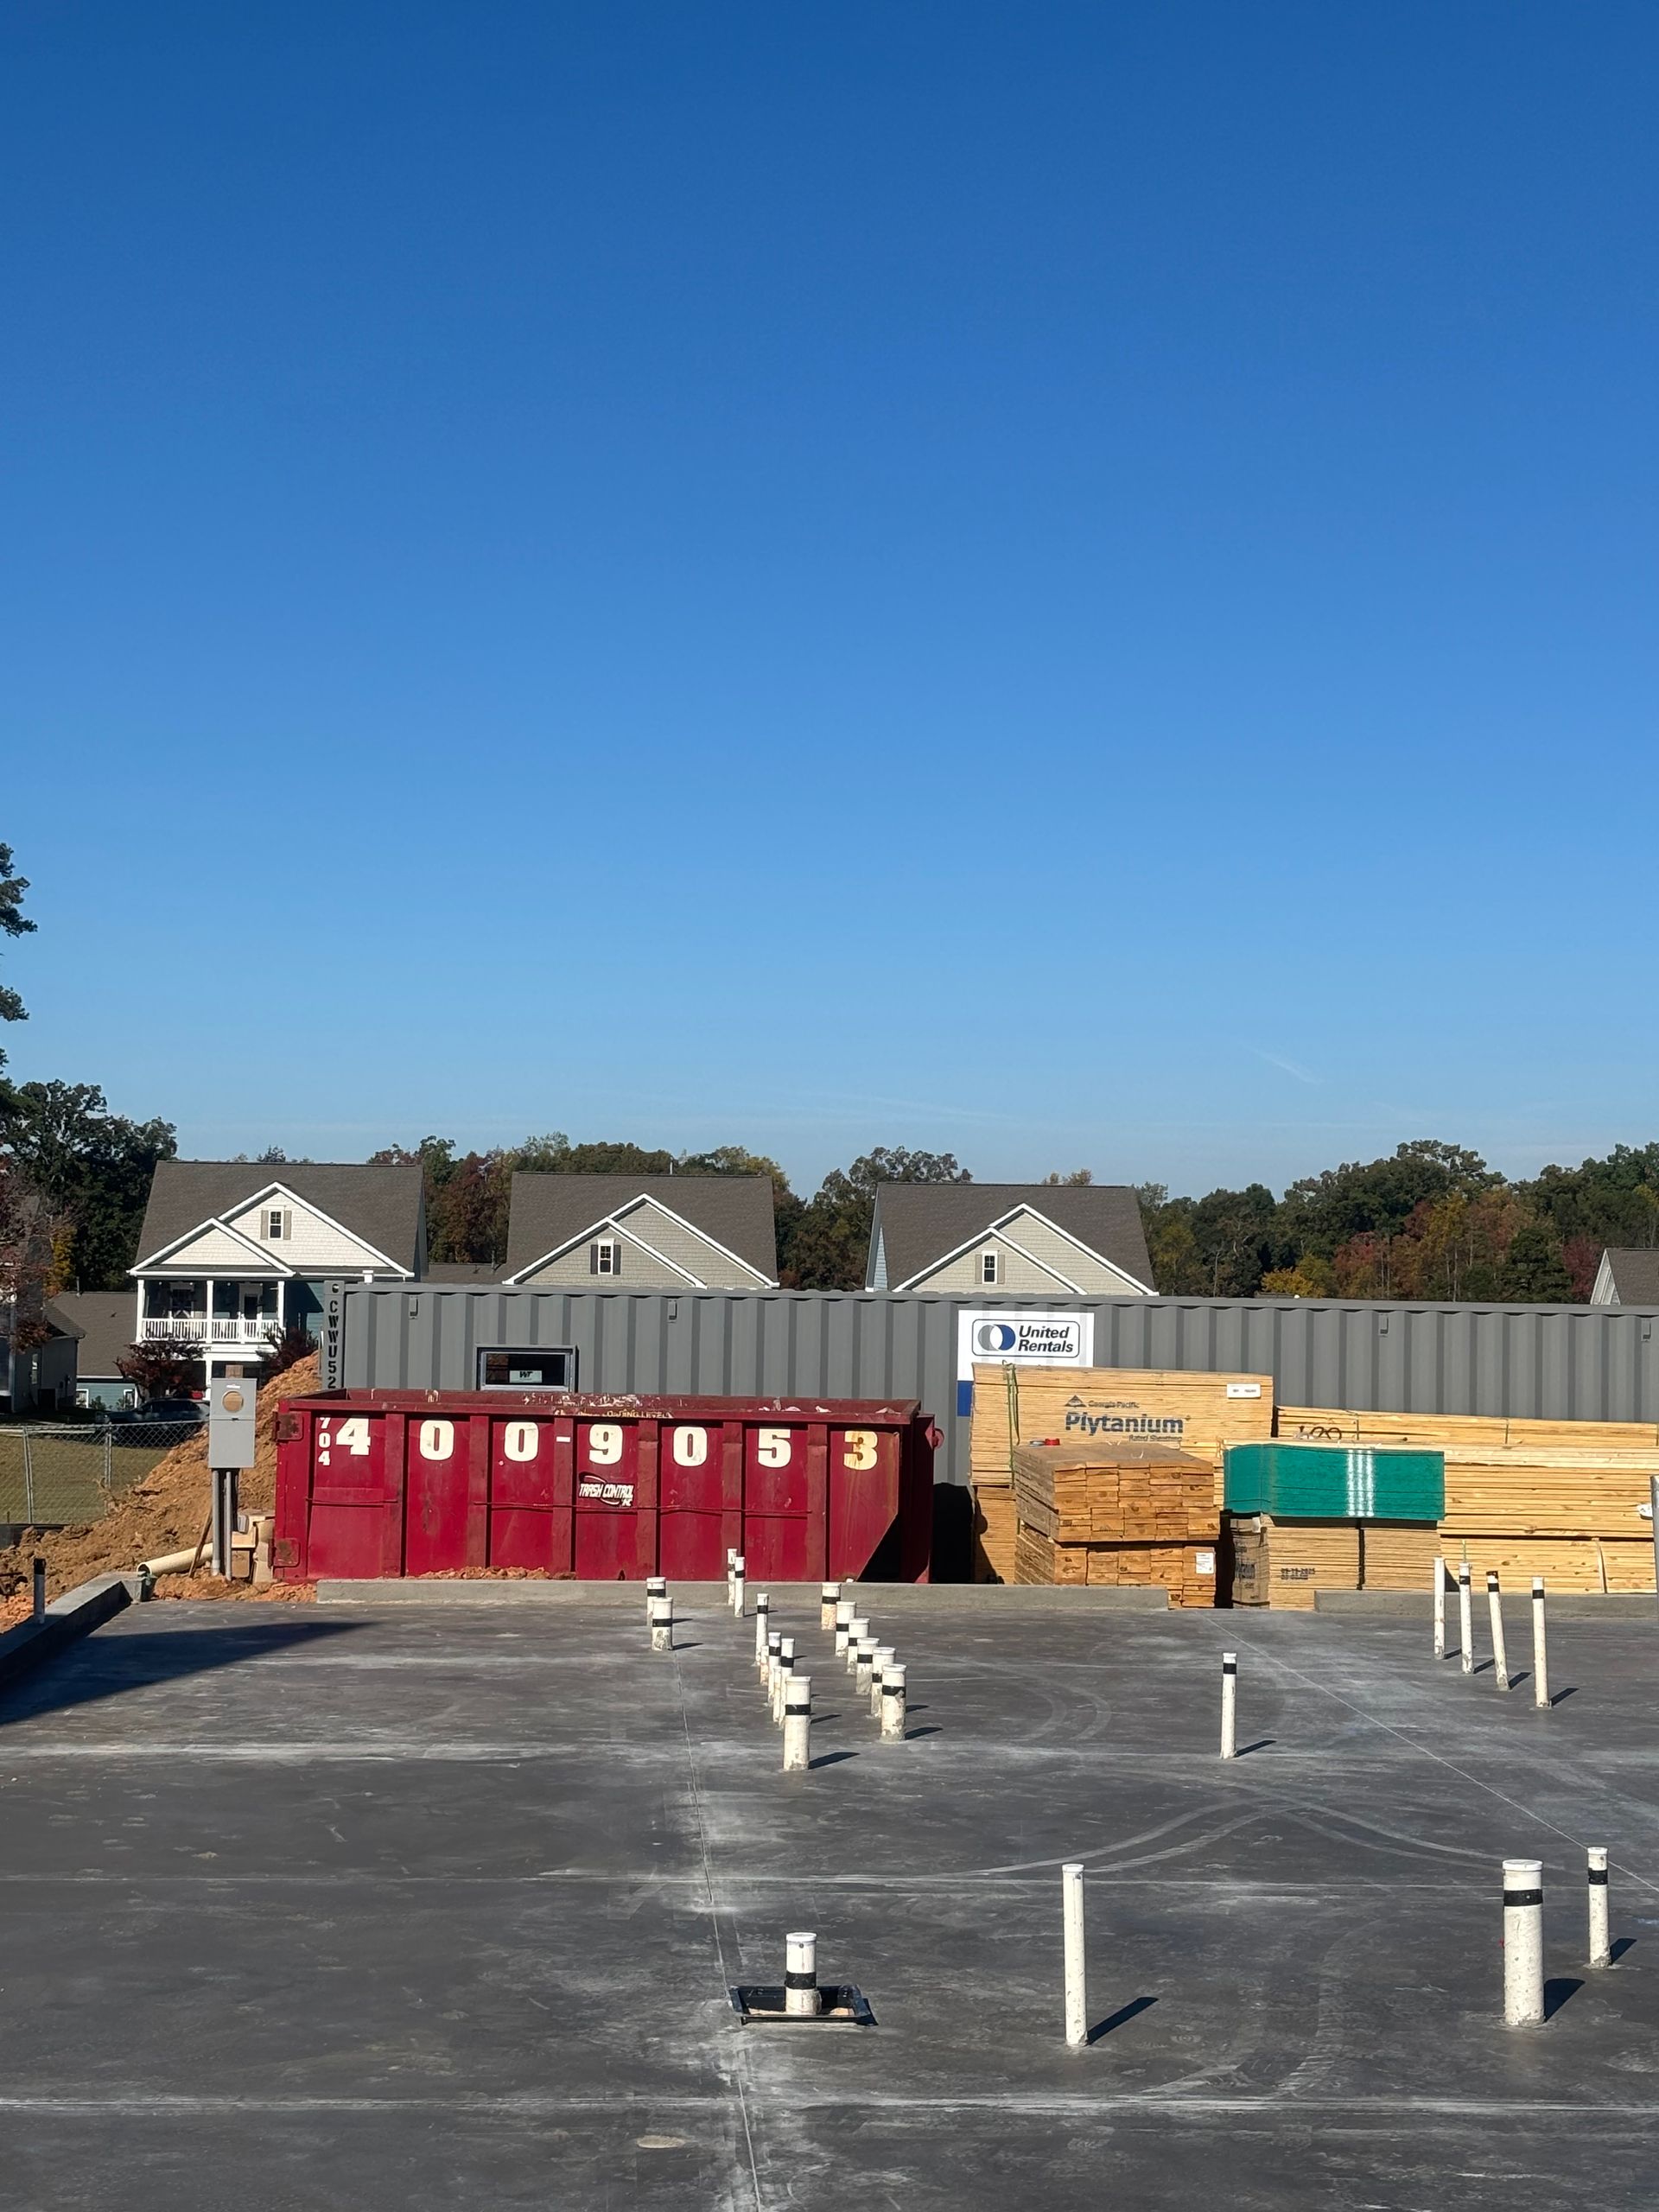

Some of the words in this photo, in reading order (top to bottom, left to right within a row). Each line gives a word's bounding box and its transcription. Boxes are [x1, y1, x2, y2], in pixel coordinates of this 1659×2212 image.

[1019, 1325, 1070, 1338] United
[1018, 1339, 1074, 1352] Rentals
[1065, 1412, 1184, 1436] Plytanium
[579, 1484, 603, 1497] TRASH
[602, 1484, 634, 1498] CONTROL
